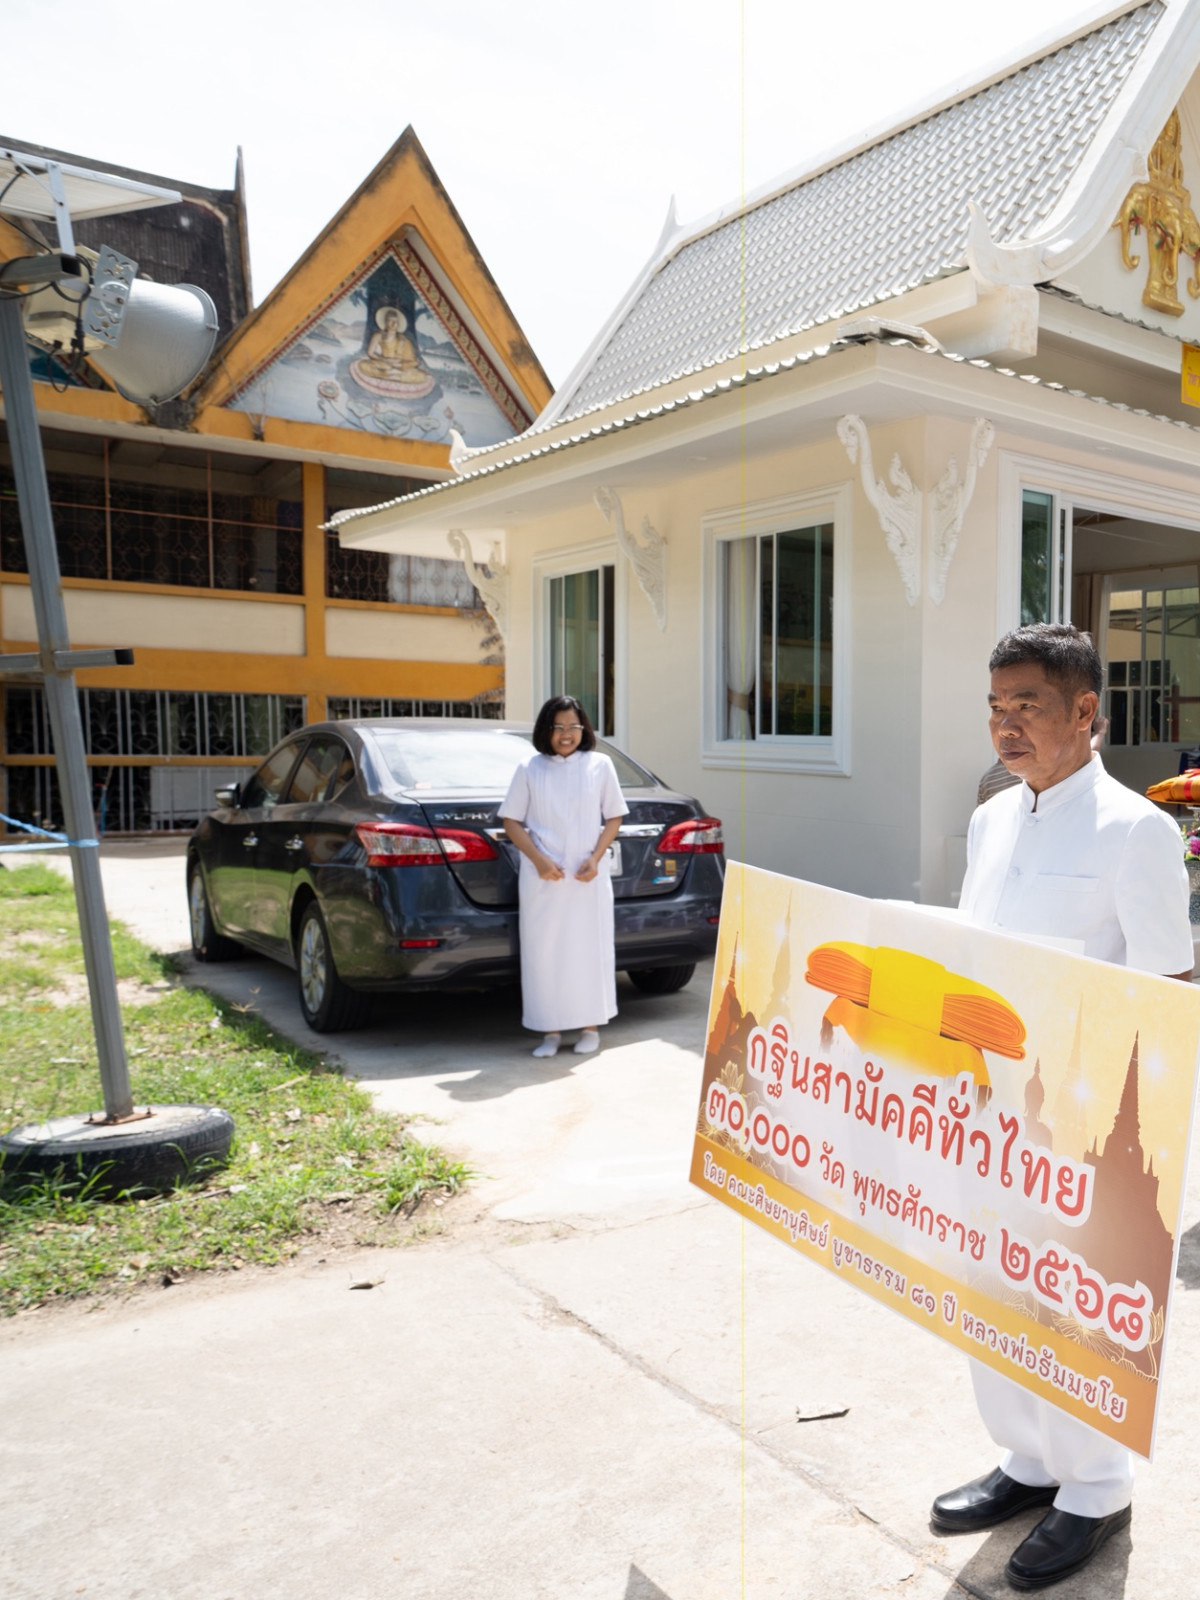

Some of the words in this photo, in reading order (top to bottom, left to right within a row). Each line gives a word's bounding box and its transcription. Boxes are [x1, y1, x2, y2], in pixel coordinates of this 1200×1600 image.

[434, 812, 492, 821] SYLPHY
[709, 1088, 811, 1168] ๓๐,๐๐๐
[819, 1141, 845, 1189] วัด
[852, 1169, 986, 1262] พุทธศักราช
[1000, 1228, 1146, 1341] ๒๕๖๘
[750, 1023, 1088, 1217] กฐินสามัคคีทั่วไทย
[704, 1153, 726, 1185] โดย
[728, 1176, 828, 1248] คณะศิษยานุศิษย์
[833, 1238, 906, 1295] บูชาธรรม
[911, 1286, 936, 1314] ๘๑
[943, 1295, 956, 1323] ปี
[963, 1313, 1125, 1419] หลวงพ่อธัมมชโย
